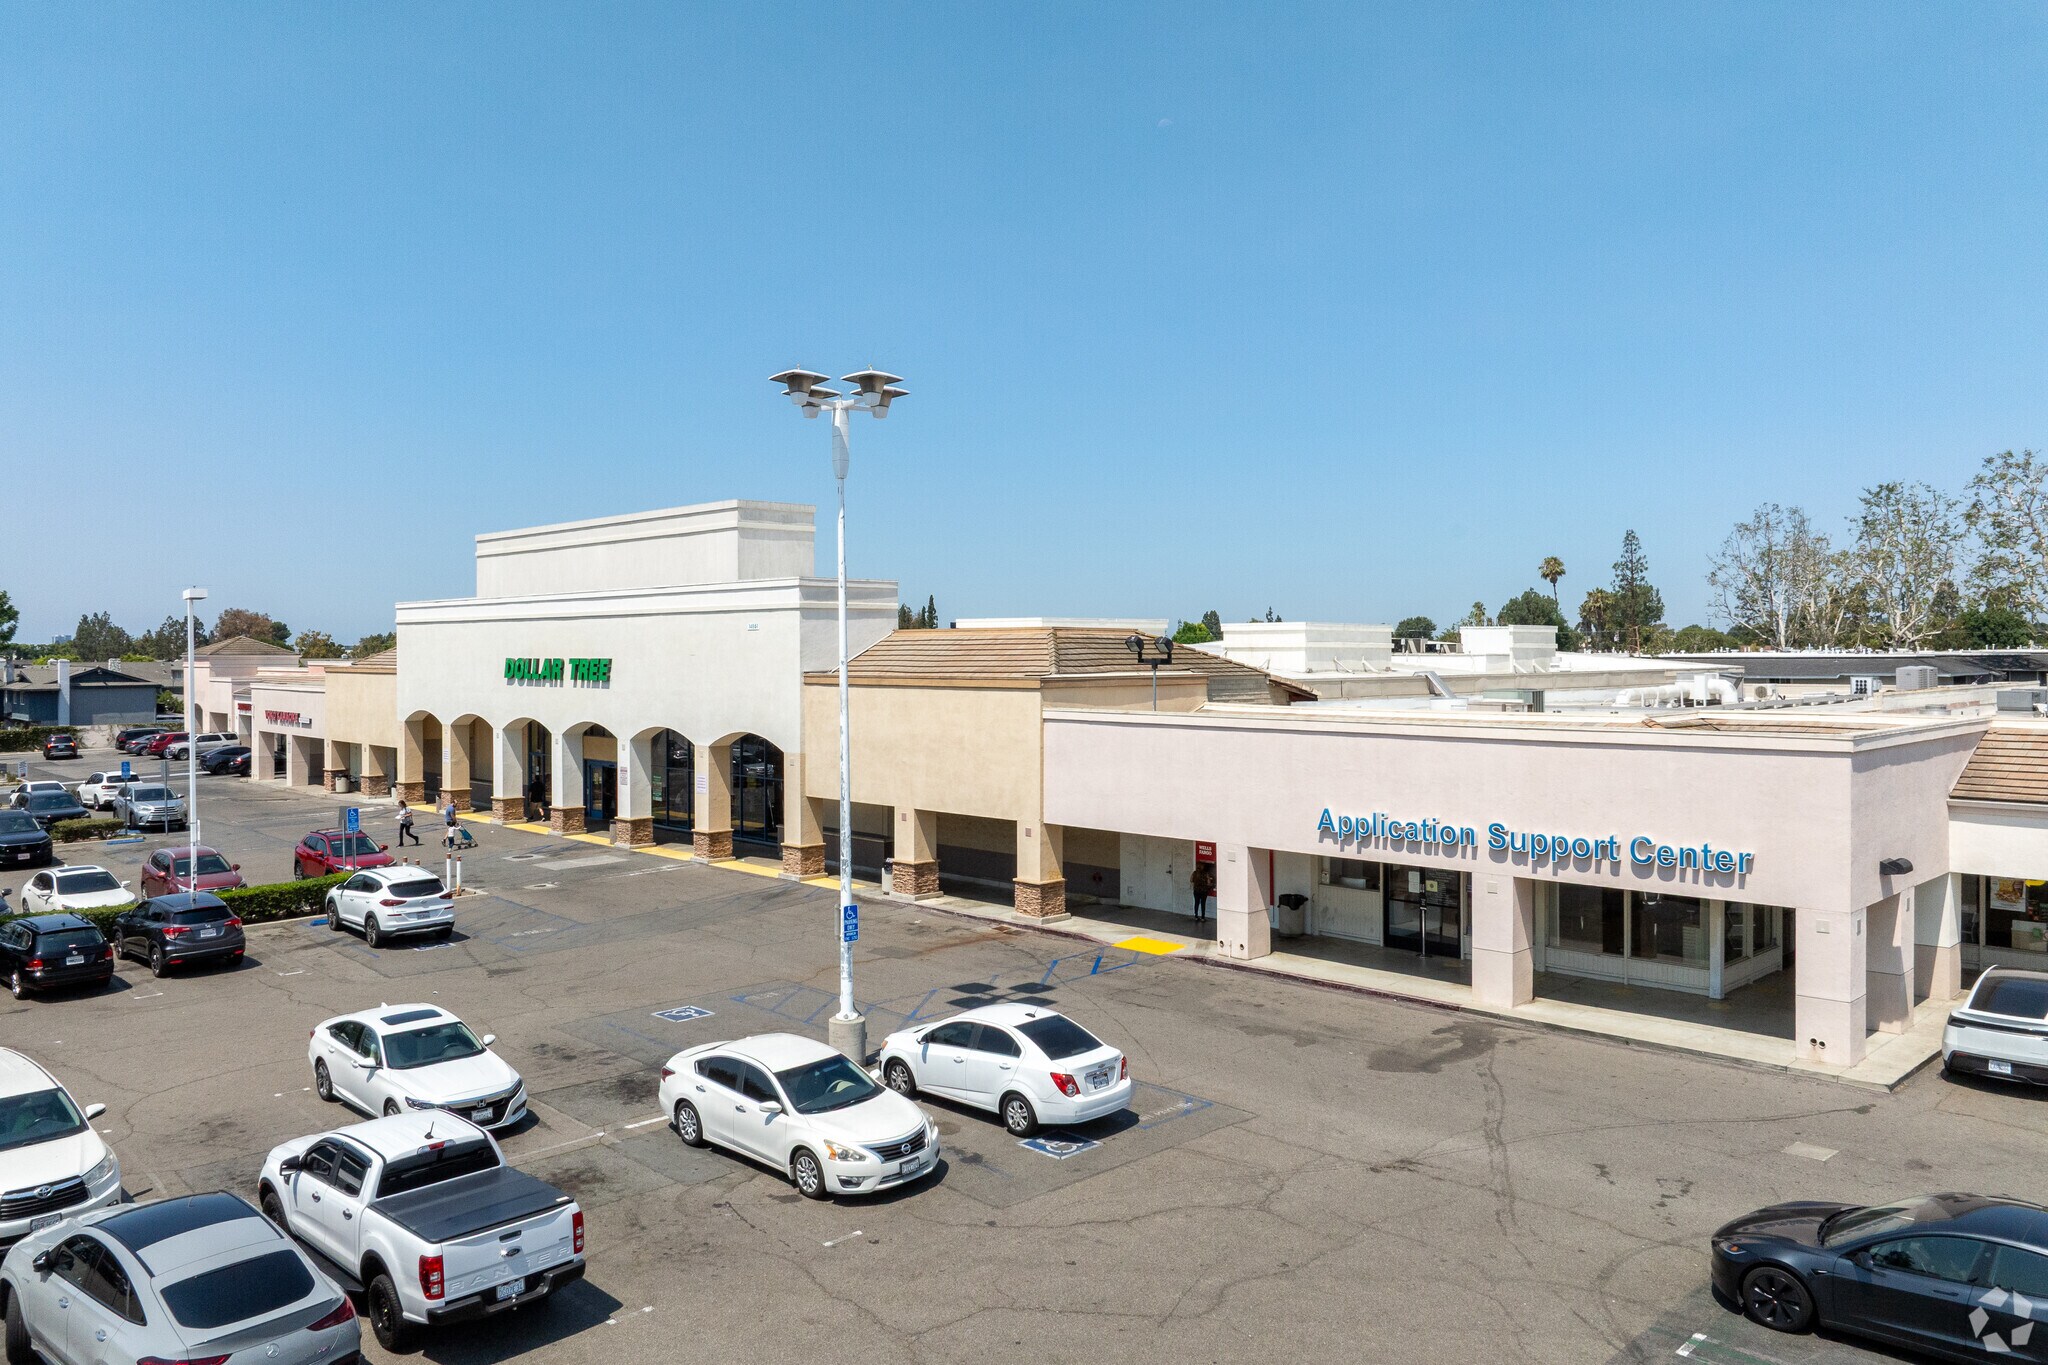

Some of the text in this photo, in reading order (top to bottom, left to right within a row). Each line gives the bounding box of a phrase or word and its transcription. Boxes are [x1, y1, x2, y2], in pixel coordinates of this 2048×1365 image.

[504, 657, 613, 682] DOLLAR TREE
[1317, 807, 1752, 873] Application Support Center
